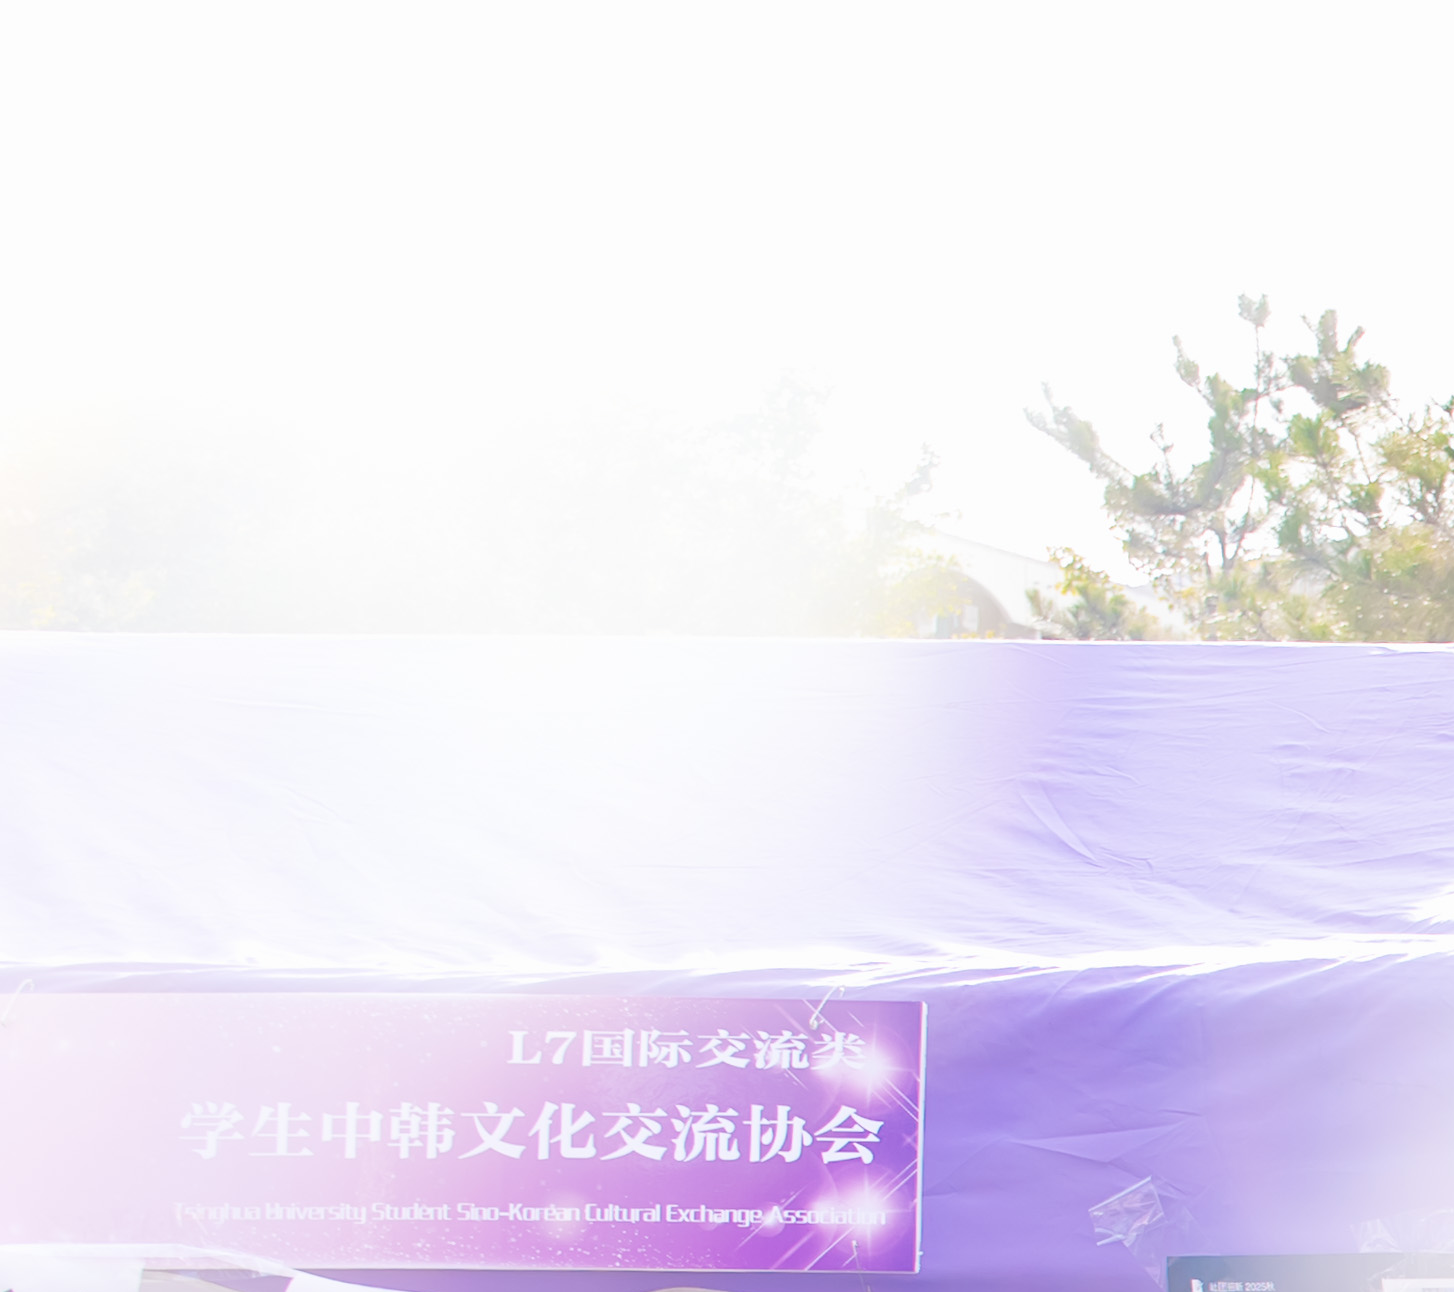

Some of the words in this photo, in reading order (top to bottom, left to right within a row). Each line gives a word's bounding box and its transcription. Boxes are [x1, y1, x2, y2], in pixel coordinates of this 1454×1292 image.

[507, 1029, 867, 1071] L7国际交流类
[178, 1102, 886, 1166] 学生中韩文化交流协会
[265, 1202, 367, 1225] University
[371, 1203, 453, 1221] Student
[457, 1202, 581, 1223] Sino-Korean
[585, 1203, 662, 1223] Cultural
[665, 1204, 763, 1227] Exchange
[769, 1204, 887, 1226] Association
